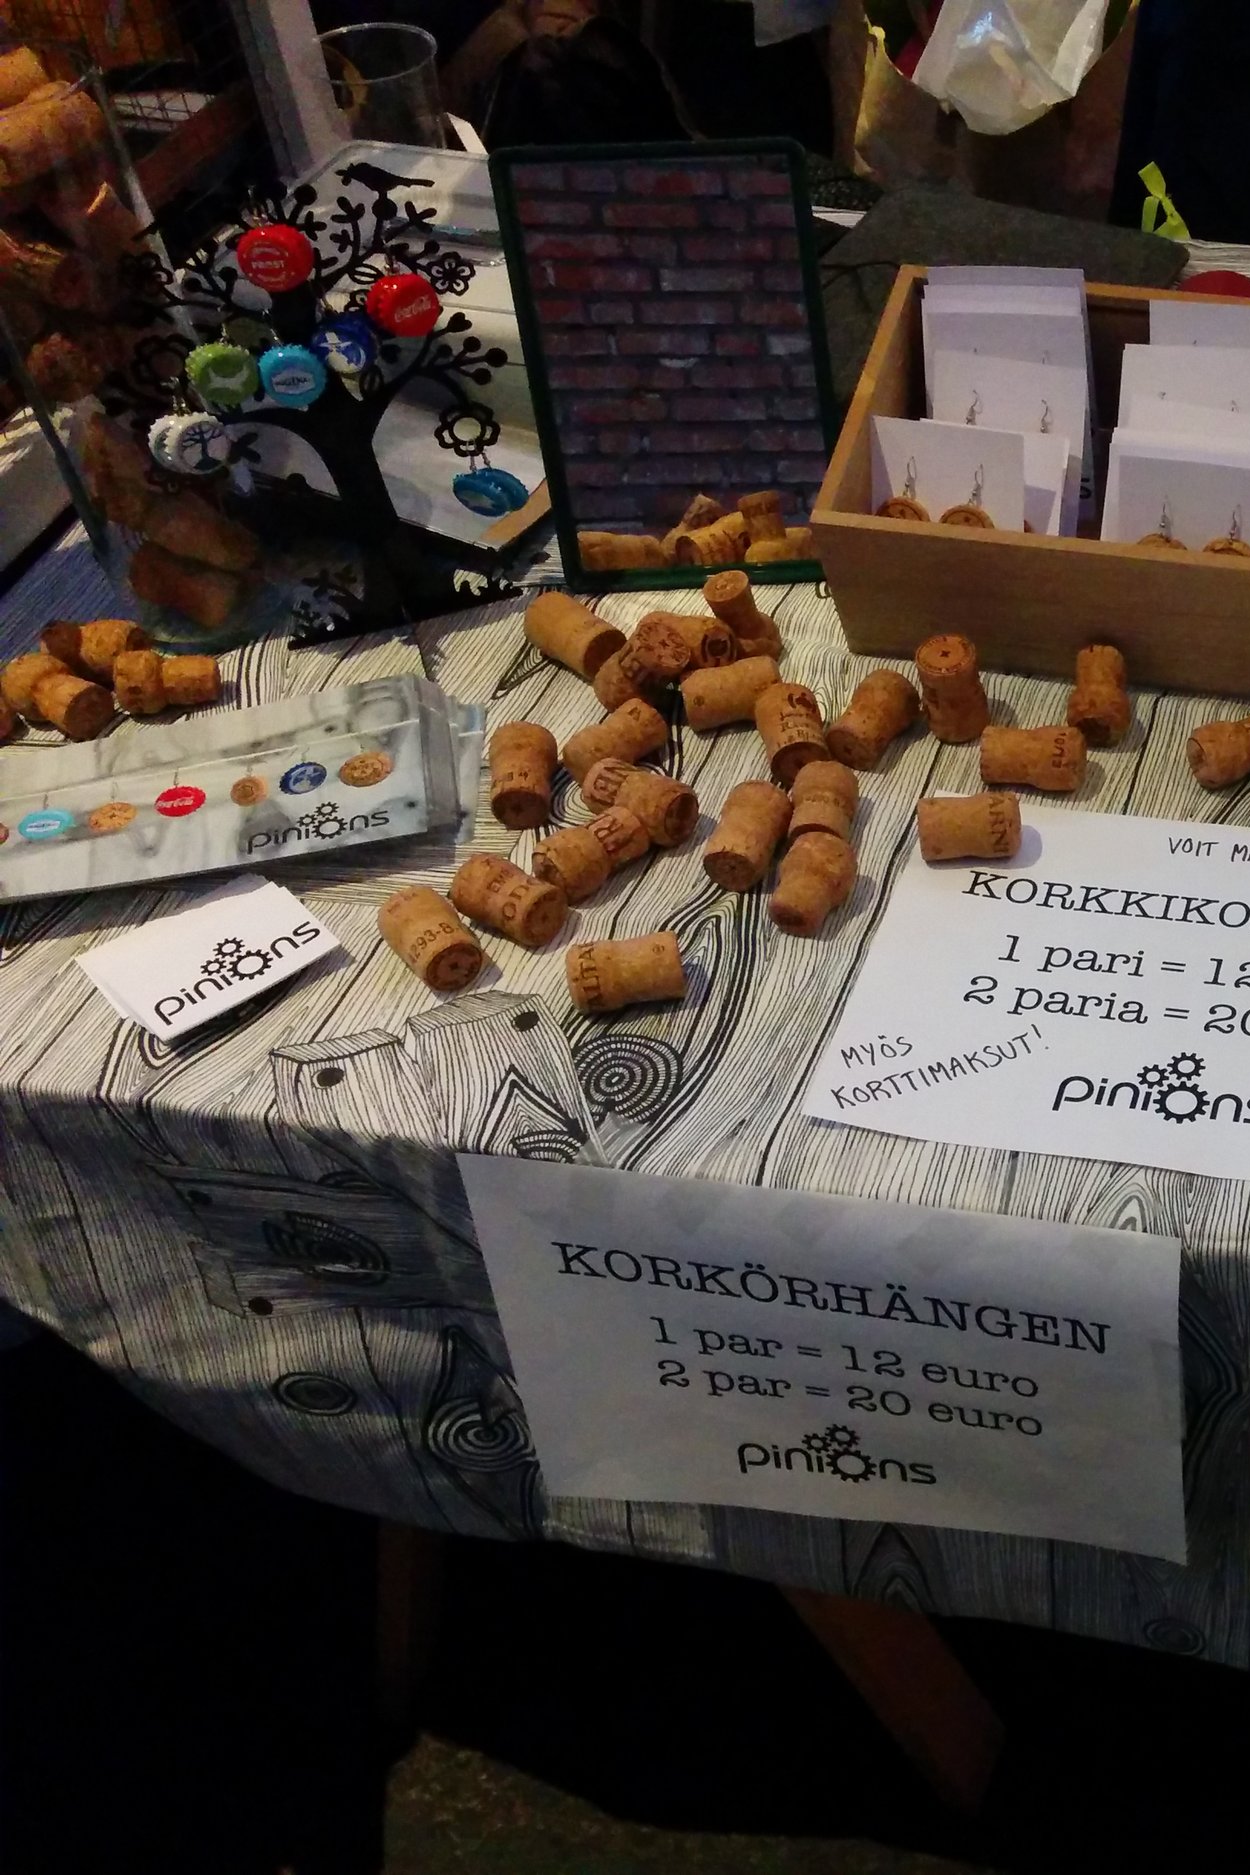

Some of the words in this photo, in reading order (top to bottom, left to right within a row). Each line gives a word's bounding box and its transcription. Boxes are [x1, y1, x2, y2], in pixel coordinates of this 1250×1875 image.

[247, 809, 390, 855] pinions
[1168, 836, 1219, 858] VOIT
[154, 921, 321, 1025] pinions
[998, 935, 1021, 963] 1
[1037, 942, 1145, 978] pari
[1161, 960, 1187, 974] =
[963, 976, 996, 1004] 2
[1007, 984, 1148, 1025] paria
[1163, 1006, 1191, 1020] =
[830, 1025, 1051, 1110] KORTTIMAKSUT!
[840, 1035, 913, 1071] MYÖS
[551, 1241, 1111, 1354] KORKÖRHÄNGEN
[650, 1316, 677, 1345] 1
[693, 1326, 783, 1358] par
[796, 1345, 823, 1358] =
[842, 1344, 905, 1379] 12
[921, 1361, 1039, 1398] euro
[657, 1360, 690, 1388] 2
[700, 1369, 791, 1401] par
[805, 1386, 831, 1398] =
[846, 1386, 912, 1417] 20
[928, 1402, 1044, 1438] euro
[738, 1434, 938, 1486] pinions
